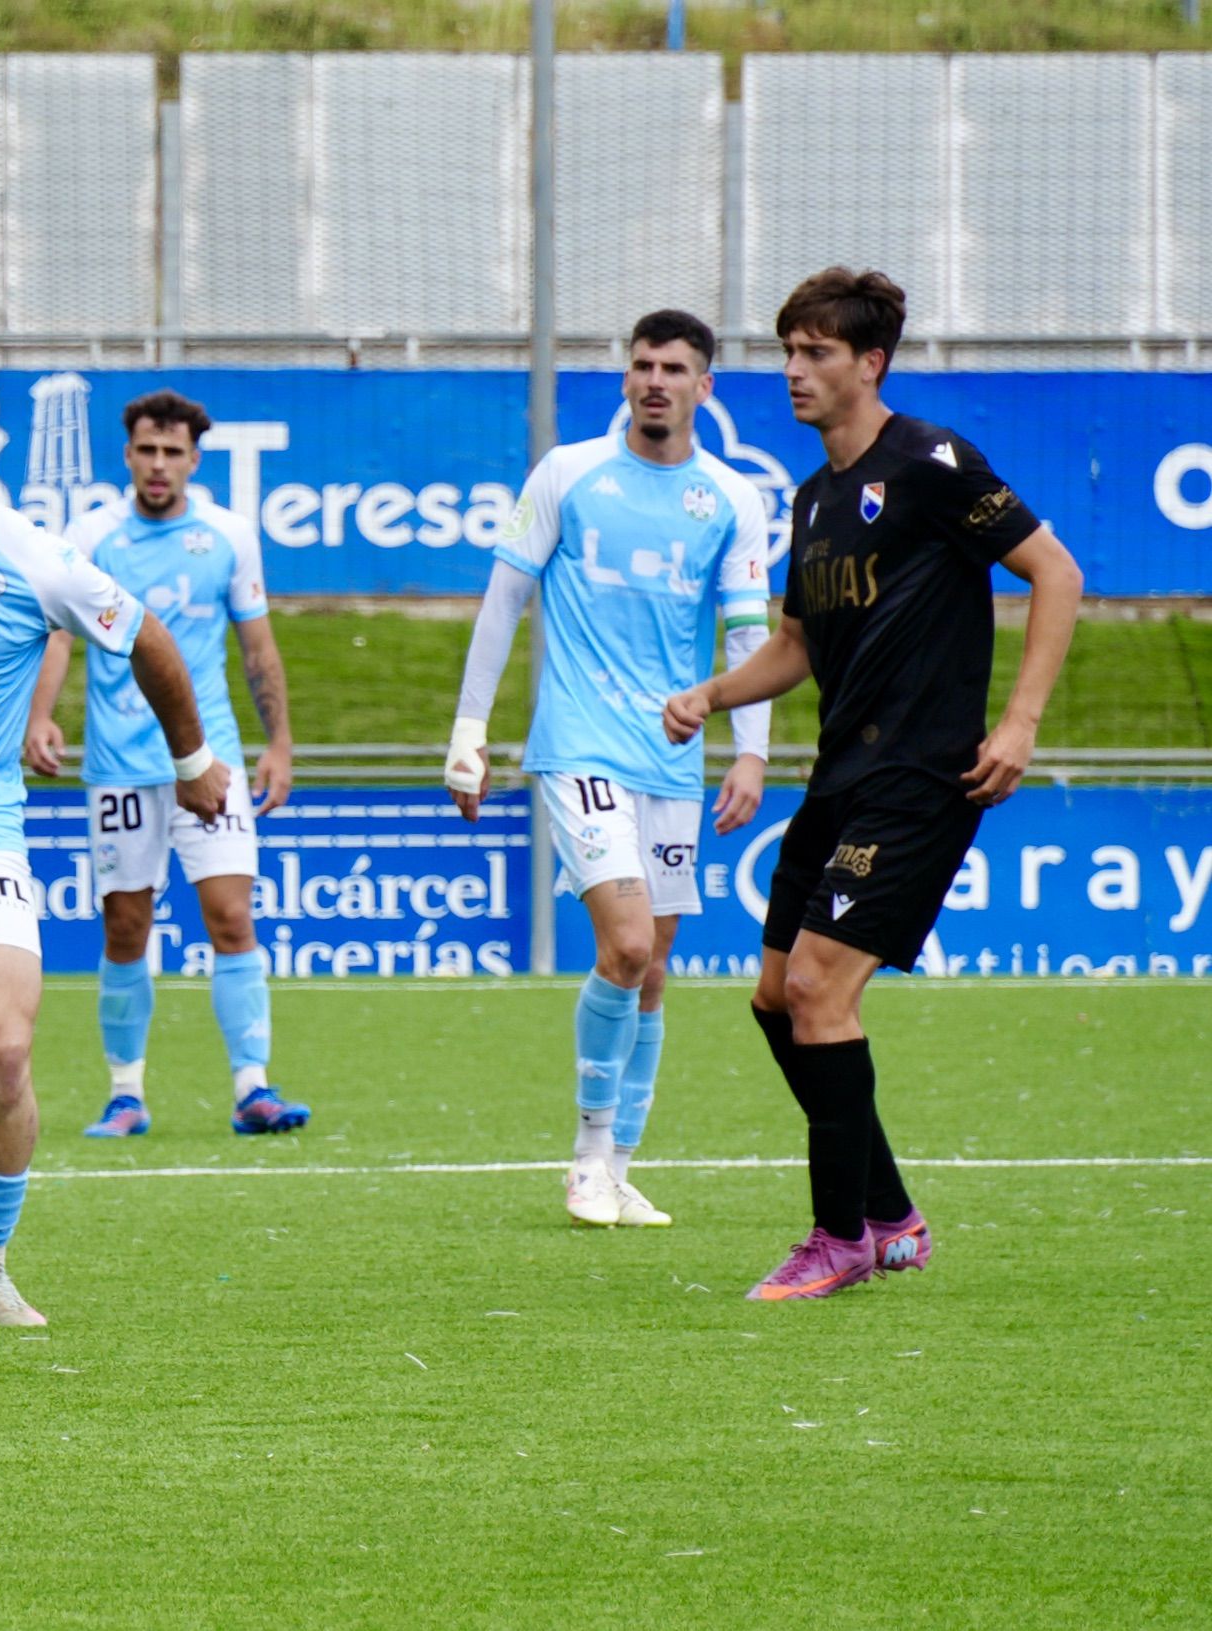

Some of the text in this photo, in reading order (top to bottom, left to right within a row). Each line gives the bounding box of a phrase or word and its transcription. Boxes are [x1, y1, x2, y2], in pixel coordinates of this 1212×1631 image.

[199, 421, 514, 548] Teresa
[101, 792, 143, 832] 20
[574, 775, 617, 815] 10
[251, 851, 511, 919] alcárcel
[942, 844, 1212, 933] aray
